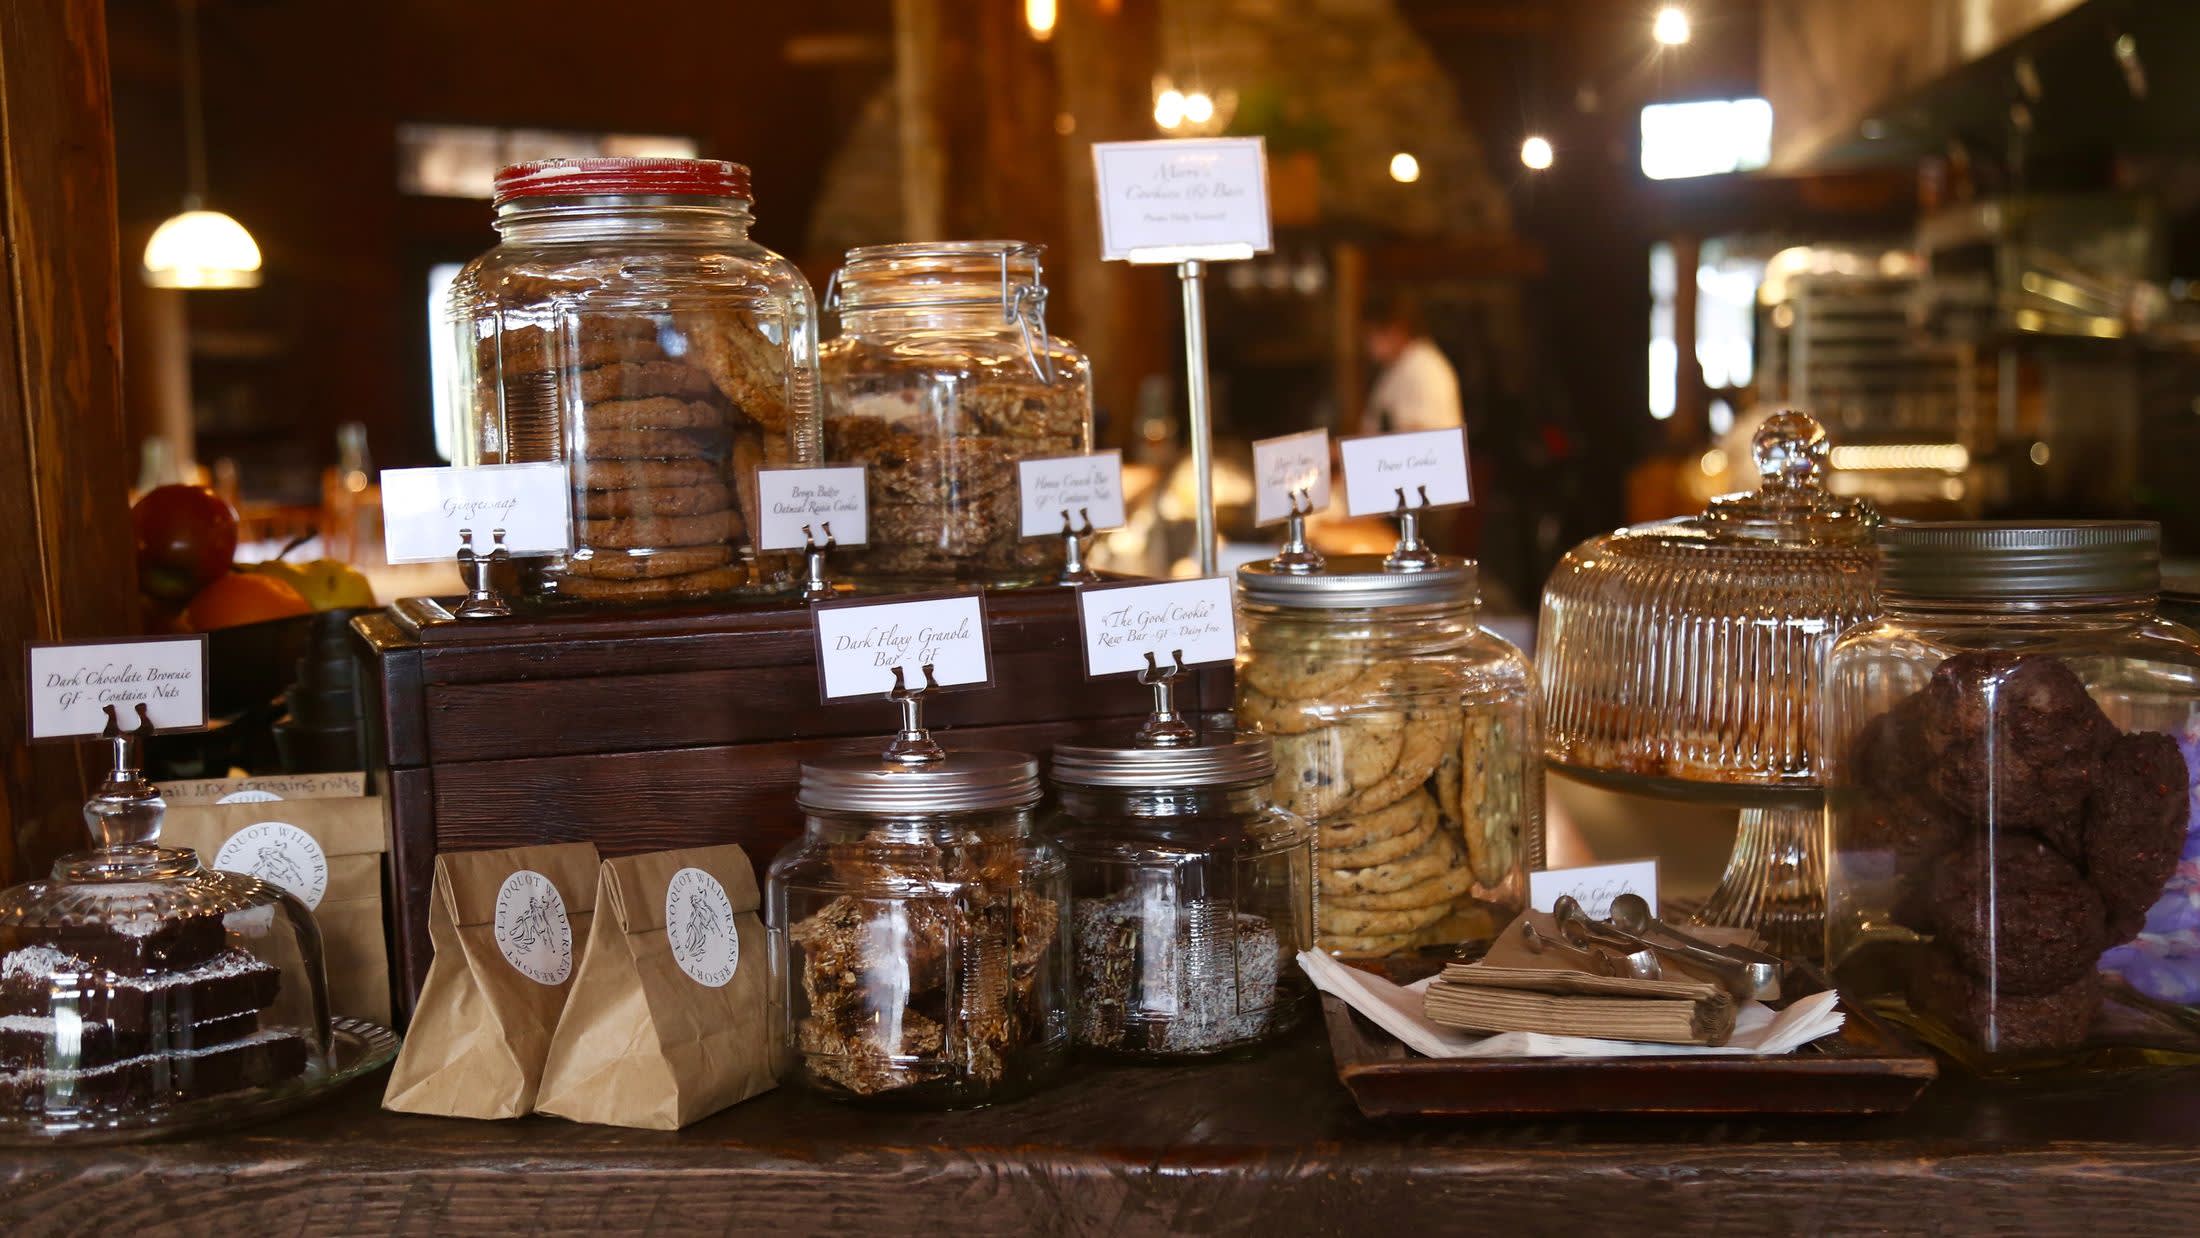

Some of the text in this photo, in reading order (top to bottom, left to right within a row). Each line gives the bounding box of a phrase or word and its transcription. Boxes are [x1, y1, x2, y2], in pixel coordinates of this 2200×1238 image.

[833, 495, 858, 512] Cookie
[1138, 602, 1174, 631] Good
[836, 618, 970, 654] Dark Flaxy Granola
[1098, 632, 1123, 648] Raw
[1127, 629, 1149, 642] Bar
[874, 651, 900, 667] Bar
[918, 647, 941, 664] GF
[46, 663, 192, 688] Dark Chocolate Brownie
[59, 690, 83, 712] GF
[98, 688, 148, 703] Contains
[153, 683, 180, 700] Nuts
[236, 777, 317, 796] contains
[320, 775, 361, 793] nuts
[220, 825, 326, 905] OQUOT WILDERNES
[498, 875, 571, 982] CLAYOQUOT WILDERNESS RESORT
[669, 872, 737, 985] CLAYOQUOT WILDERNESS RESORT
